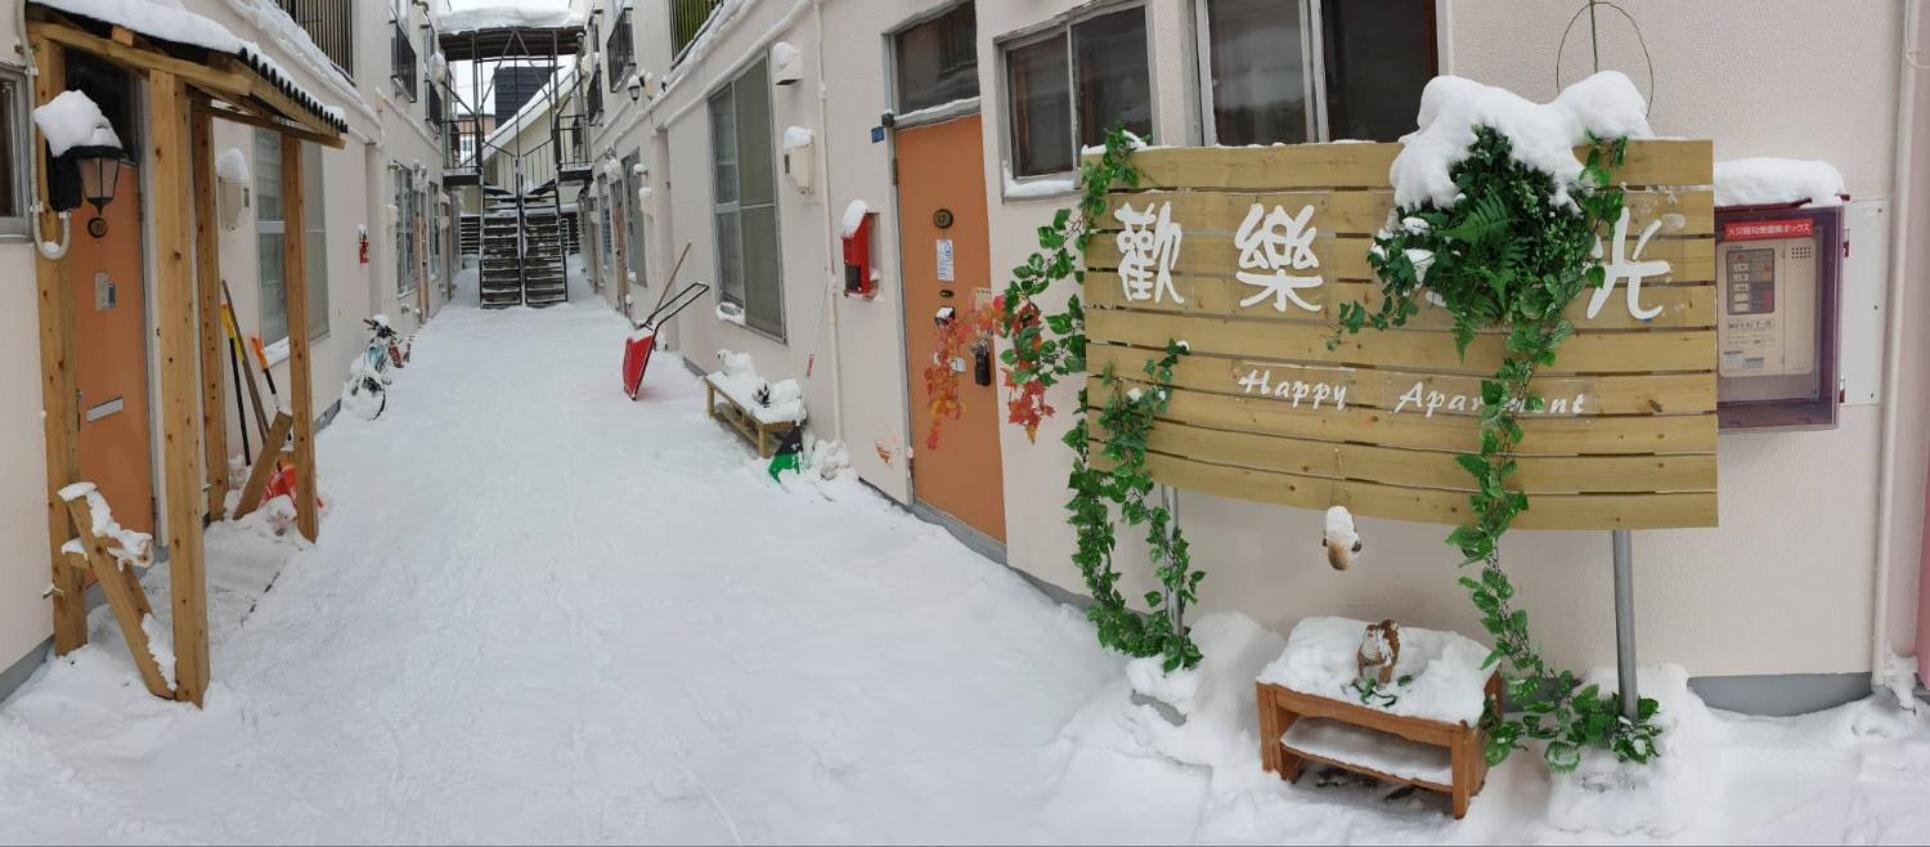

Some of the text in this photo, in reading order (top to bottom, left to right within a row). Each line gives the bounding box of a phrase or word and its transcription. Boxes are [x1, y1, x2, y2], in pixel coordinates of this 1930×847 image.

[1114, 201, 1671, 320] 歡樂光
[1238, 369, 1585, 418] Happy Aparmnt
